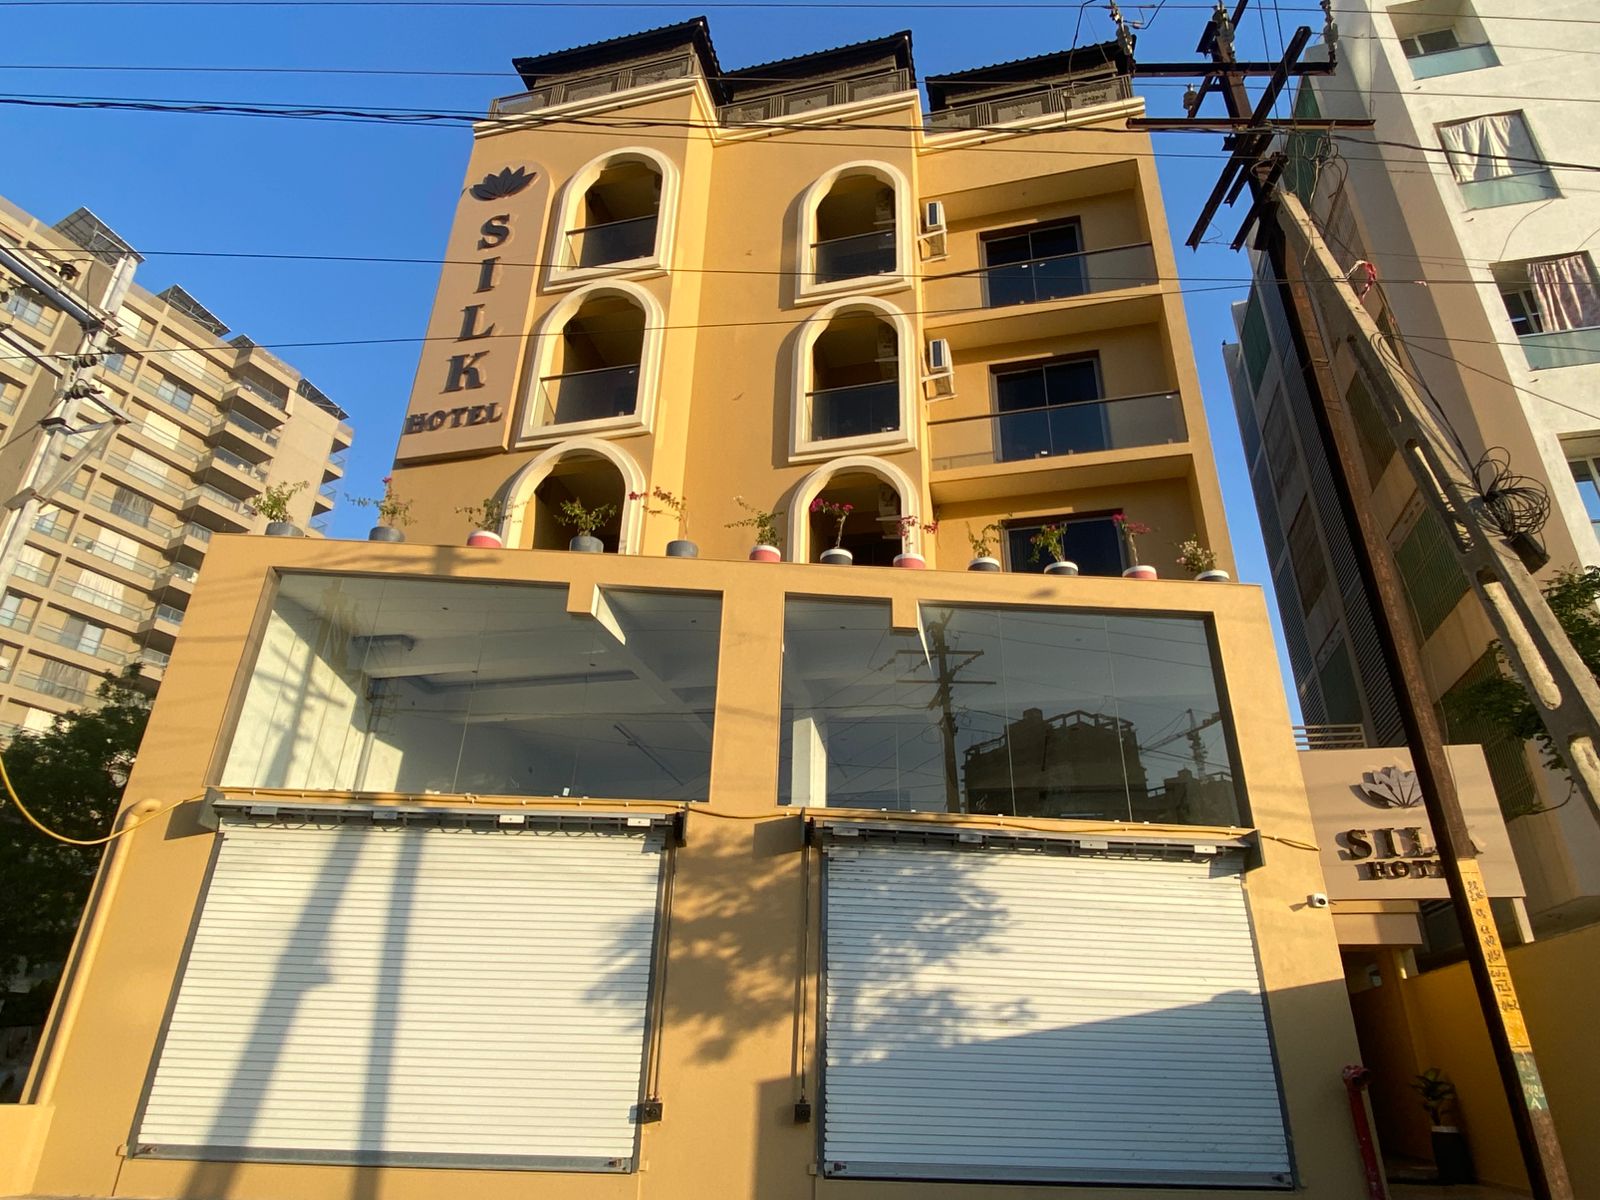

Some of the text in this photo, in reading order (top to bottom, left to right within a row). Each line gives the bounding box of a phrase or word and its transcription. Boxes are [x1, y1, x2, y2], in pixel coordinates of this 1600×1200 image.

[439, 213, 509, 394] SILK
[404, 402, 503, 435] HOTEL
[1336, 827, 1440, 860] SIL
